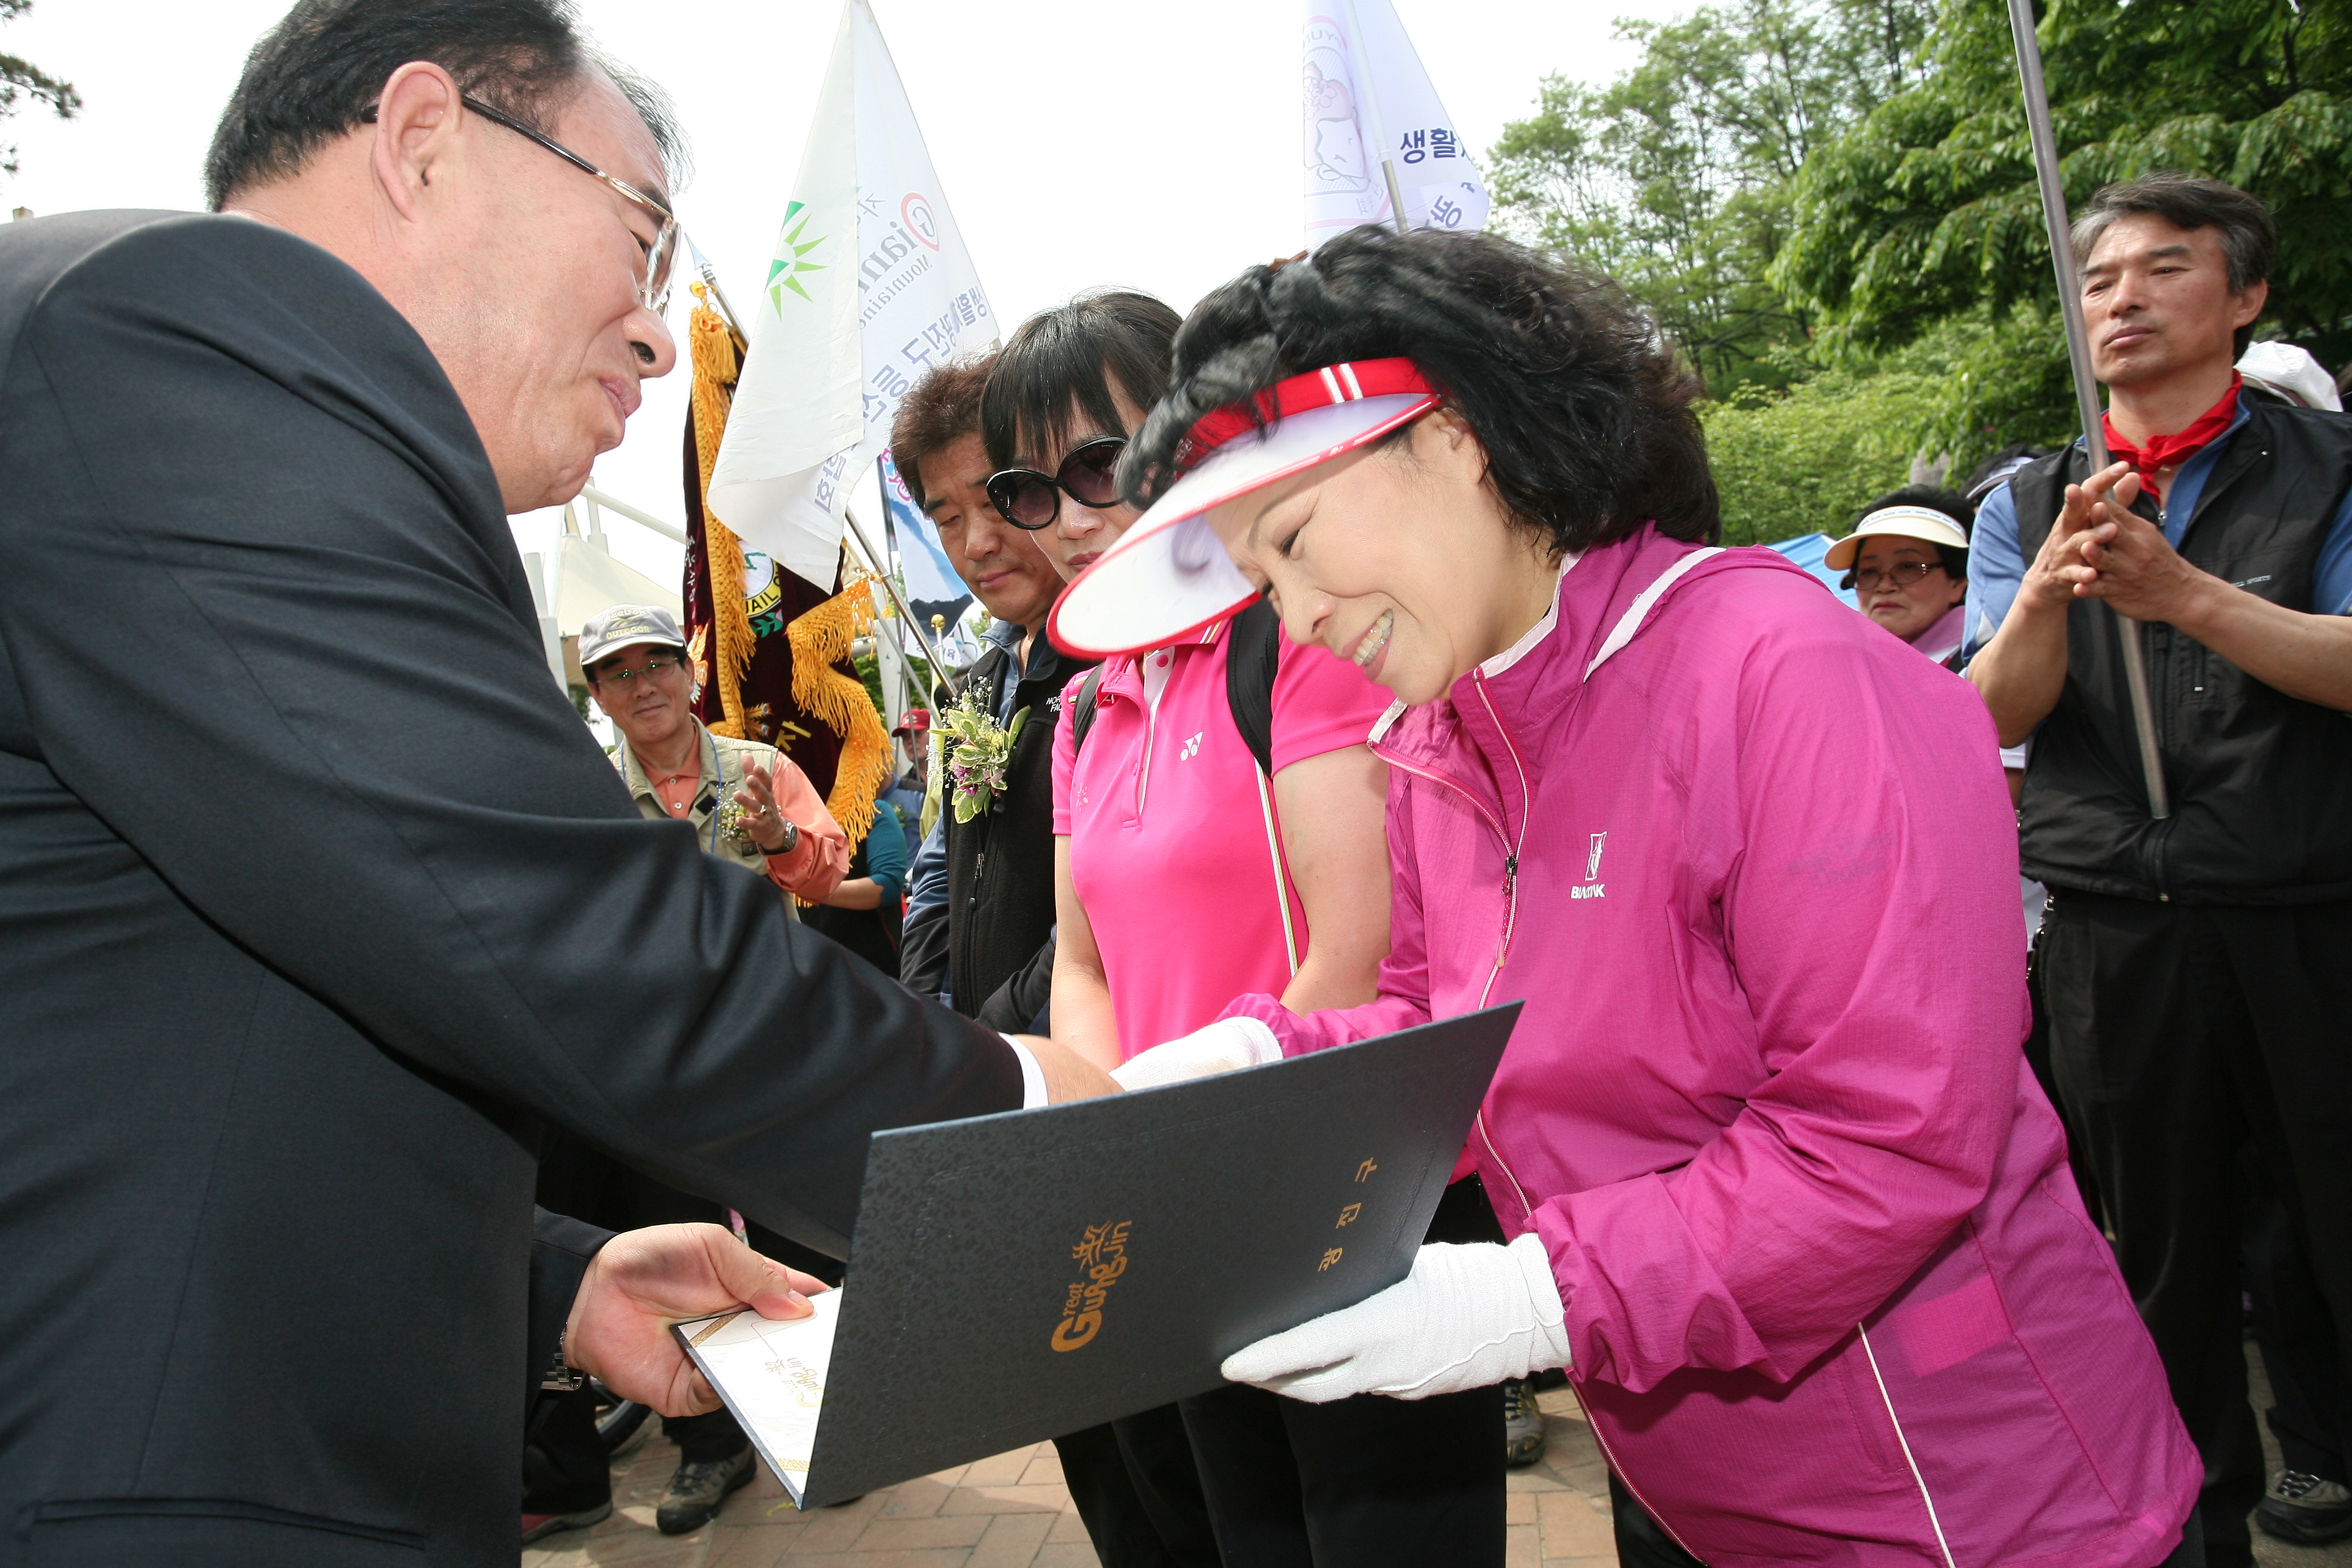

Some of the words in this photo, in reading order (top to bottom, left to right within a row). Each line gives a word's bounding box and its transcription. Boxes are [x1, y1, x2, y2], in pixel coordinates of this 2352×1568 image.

[1400, 128, 1465, 164] 생활
[606, 625, 652, 640] OUTDOOR
[1050, 703, 1062, 712] FAC
